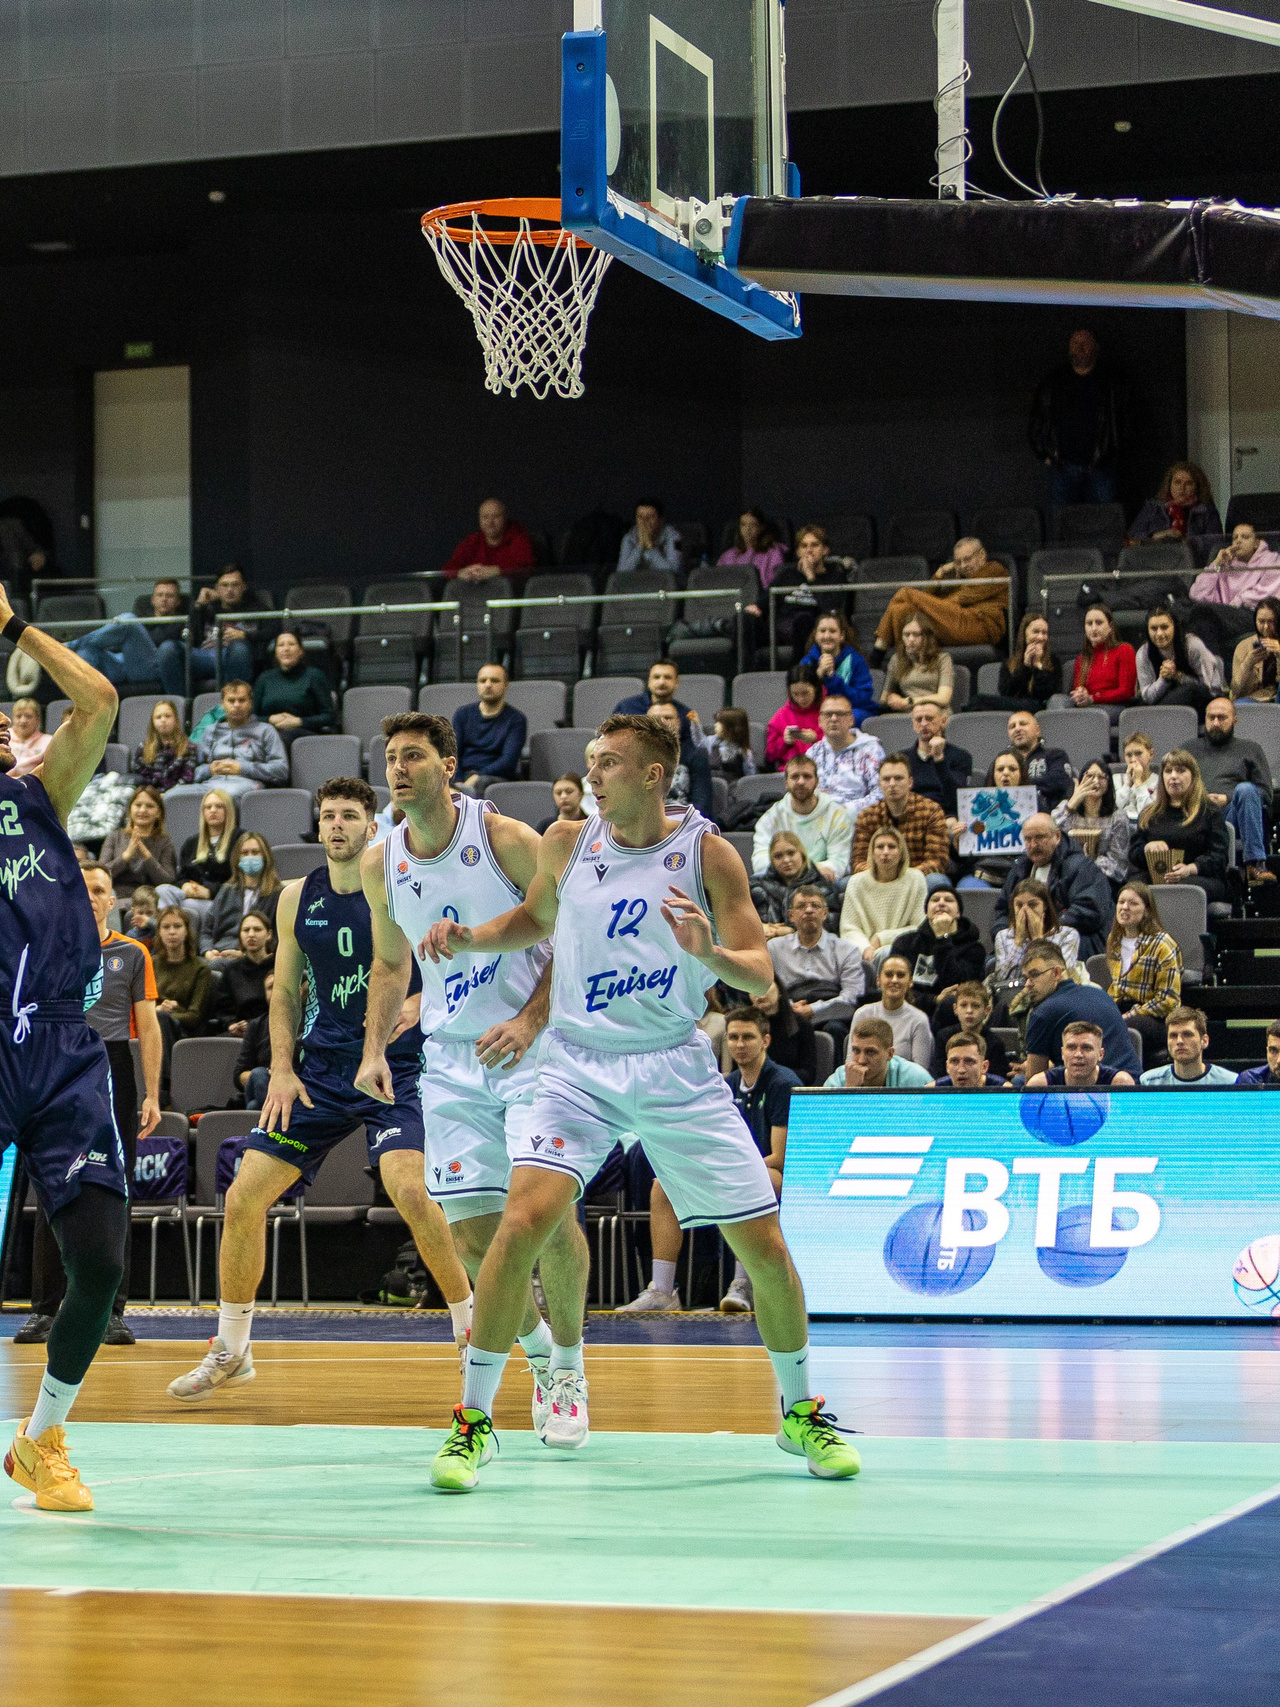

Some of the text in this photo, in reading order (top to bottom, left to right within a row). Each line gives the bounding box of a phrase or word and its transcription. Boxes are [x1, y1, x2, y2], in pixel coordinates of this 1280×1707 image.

[305, 918, 329, 928] Kempa
[606, 898, 648, 939] 12
[337, 926, 354, 957] 0
[444, 953, 502, 1014] Enisey
[585, 964, 678, 1013] Enisey
[268, 1131, 309, 1153] евроопт
[939, 1157, 1162, 1248] ВТБ
